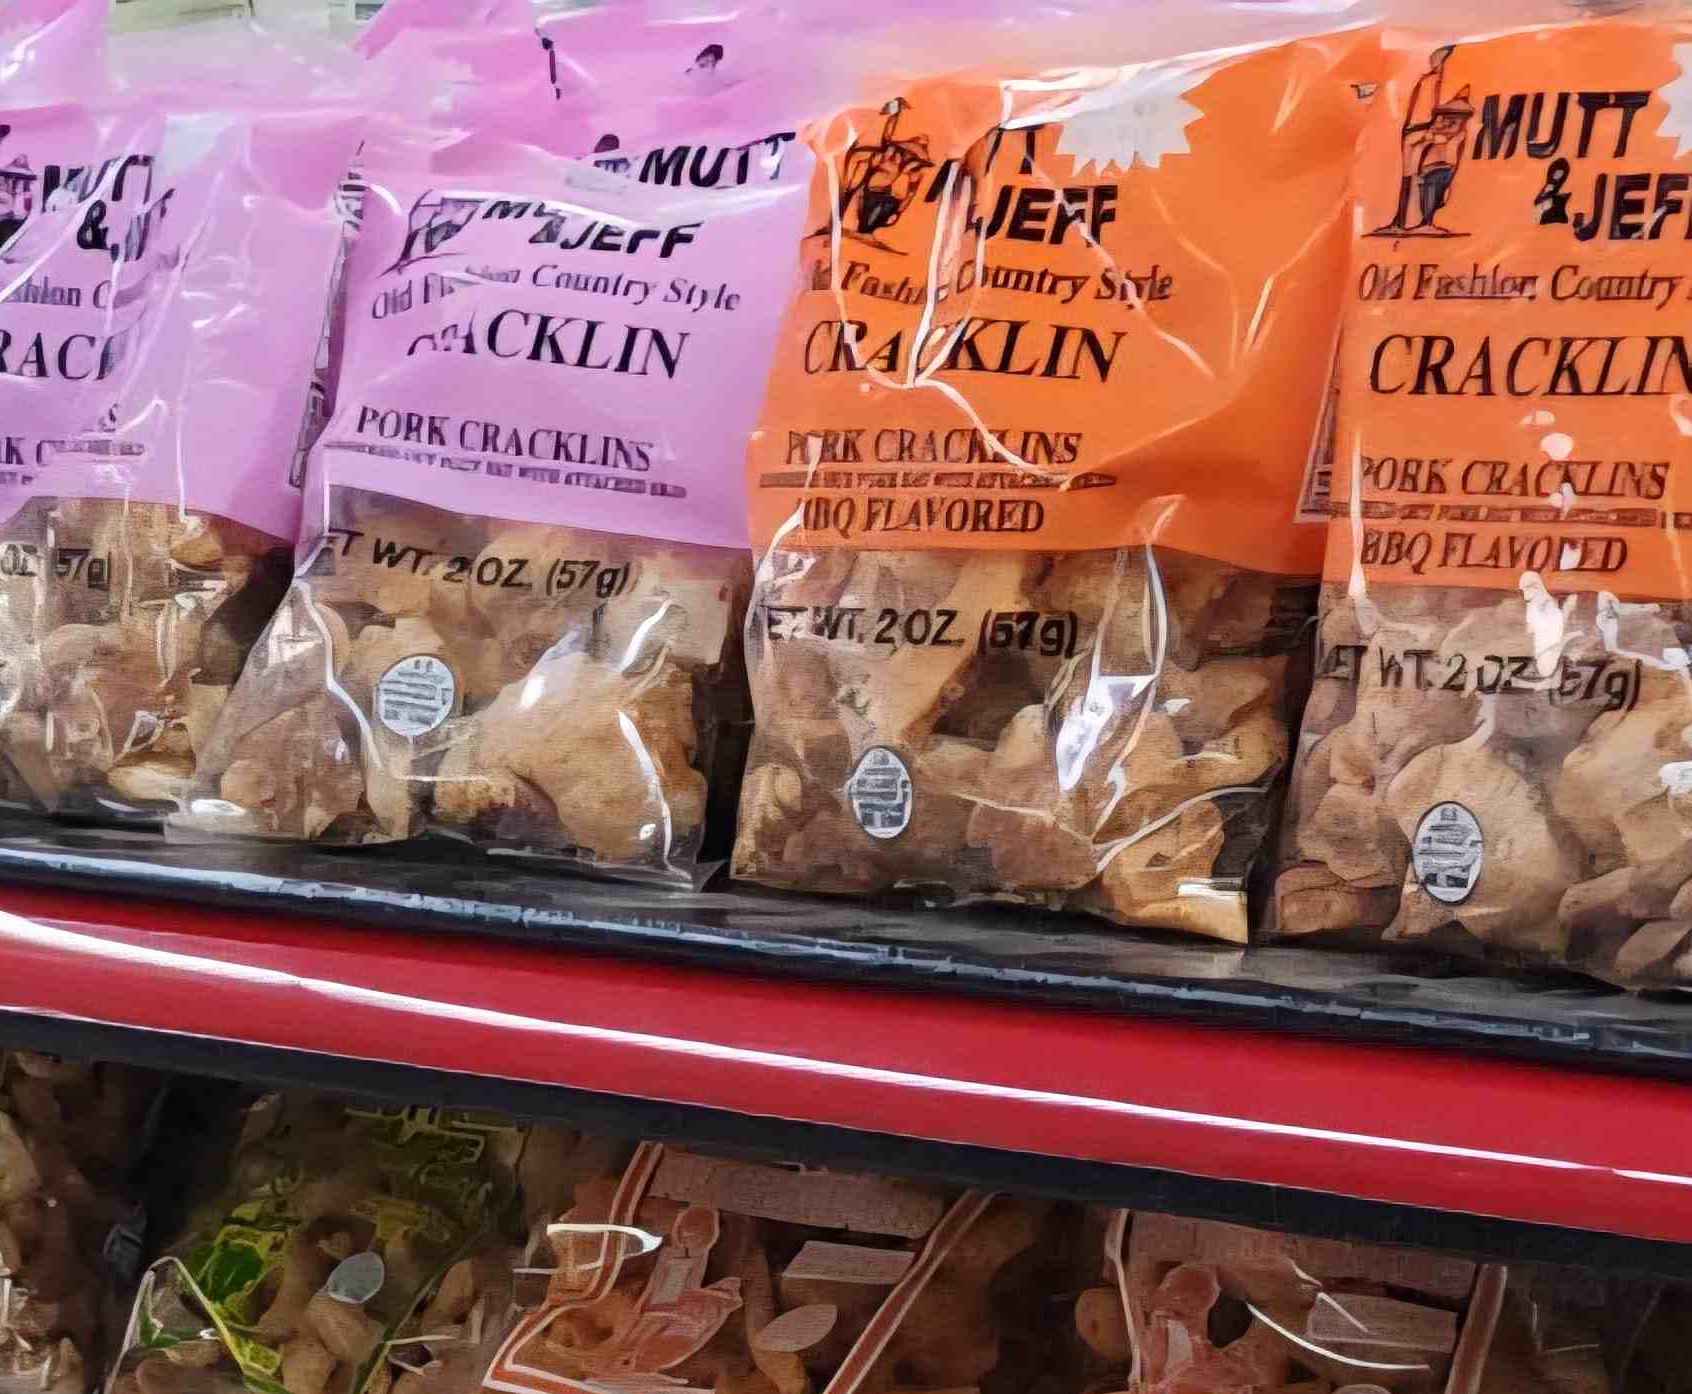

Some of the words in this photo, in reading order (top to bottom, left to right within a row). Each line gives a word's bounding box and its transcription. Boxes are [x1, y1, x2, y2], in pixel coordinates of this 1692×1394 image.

[1472, 90, 1652, 160] MUTT
[1534, 157, 1572, 225] &
[1574, 172, 1692, 242] JEF
[77, 199, 109, 250] &
[560, 221, 703, 258] JEFF
[532, 264, 656, 305] Country
[662, 277, 741, 312] Style
[1551, 264, 1684, 311] Country
[357, 405, 450, 446] PORK
[460, 420, 654, 472] CRACKLINS
[1361, 456, 1453, 495] PORK
[1461, 460, 1671, 500] CRACKLINS
[862, 497, 1044, 532] FLAVORED
[1360, 530, 1432, 575] BBQ
[546, 557, 631, 600] (57g)
[978, 609, 1077, 658] (57g)
